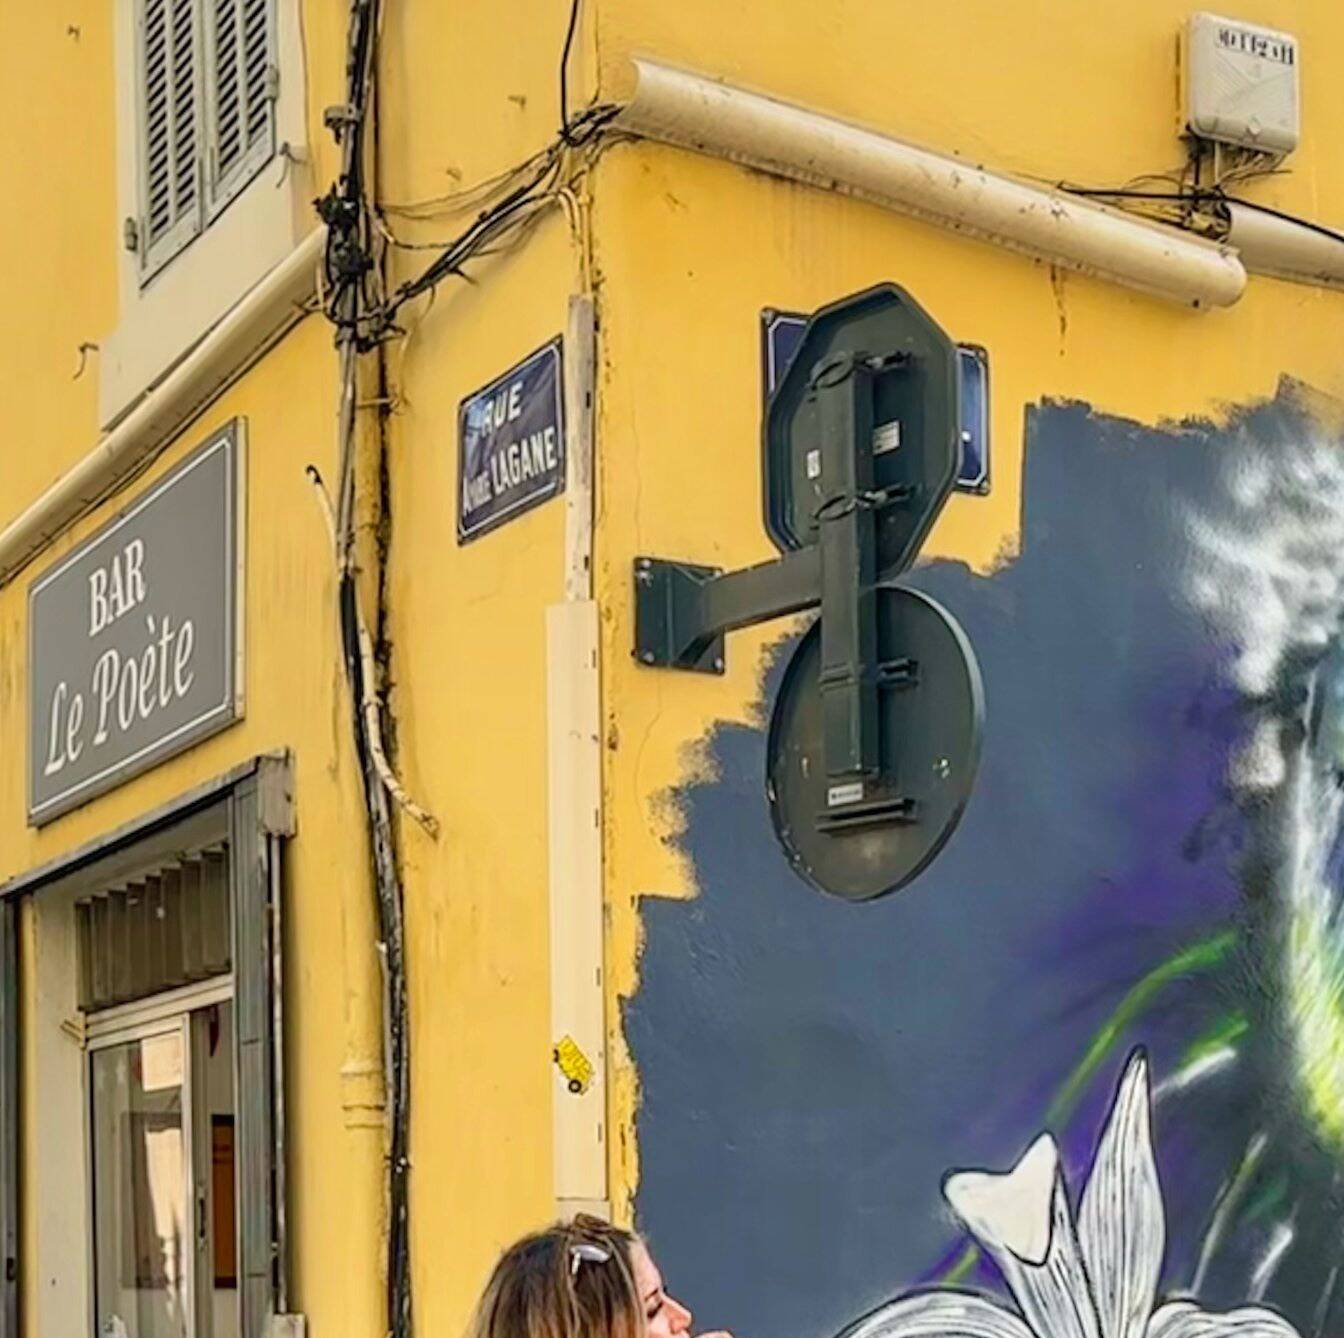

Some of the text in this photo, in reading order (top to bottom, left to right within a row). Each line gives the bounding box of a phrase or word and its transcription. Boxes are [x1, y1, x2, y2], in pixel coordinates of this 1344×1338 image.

[491, 425, 558, 495] LAGANE
[89, 538, 147, 637] BAR
[44, 614, 195, 776] Le Poète
